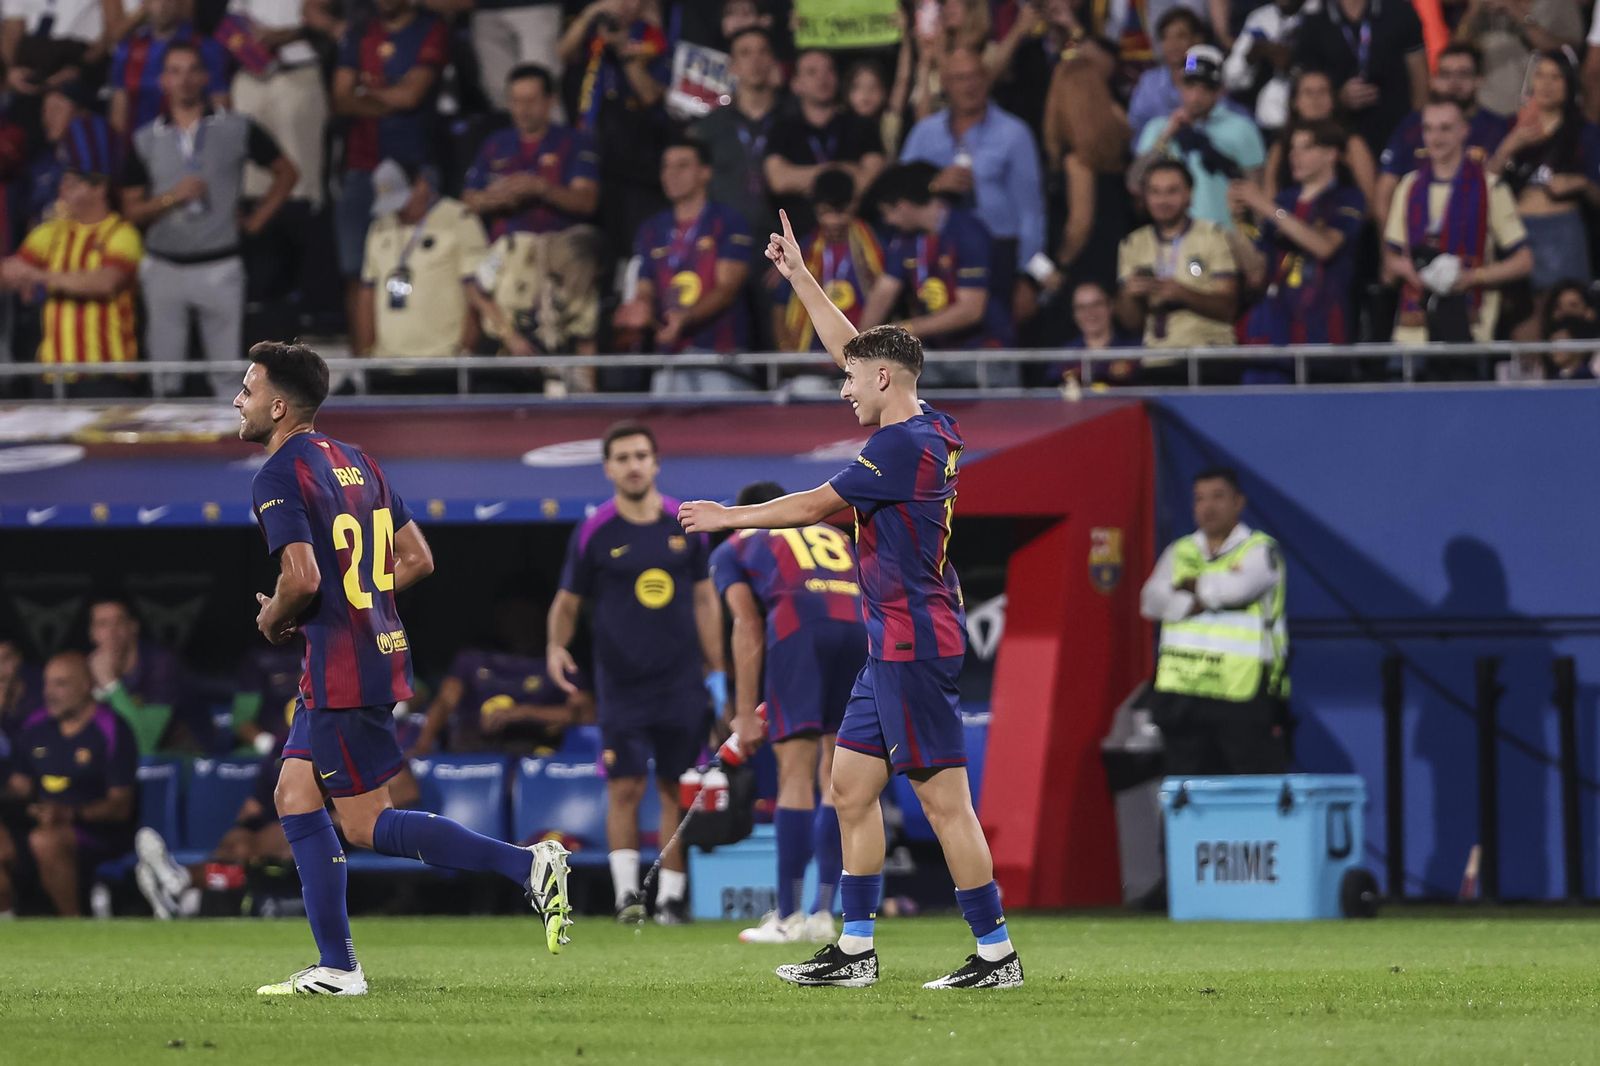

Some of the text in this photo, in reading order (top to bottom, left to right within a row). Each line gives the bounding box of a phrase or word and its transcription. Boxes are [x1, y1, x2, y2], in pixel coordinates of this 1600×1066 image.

[332, 466, 365, 487] ERIC
[332, 507, 395, 610] 24
[768, 525, 853, 573] 18
[1195, 840, 1279, 884] PRIME
